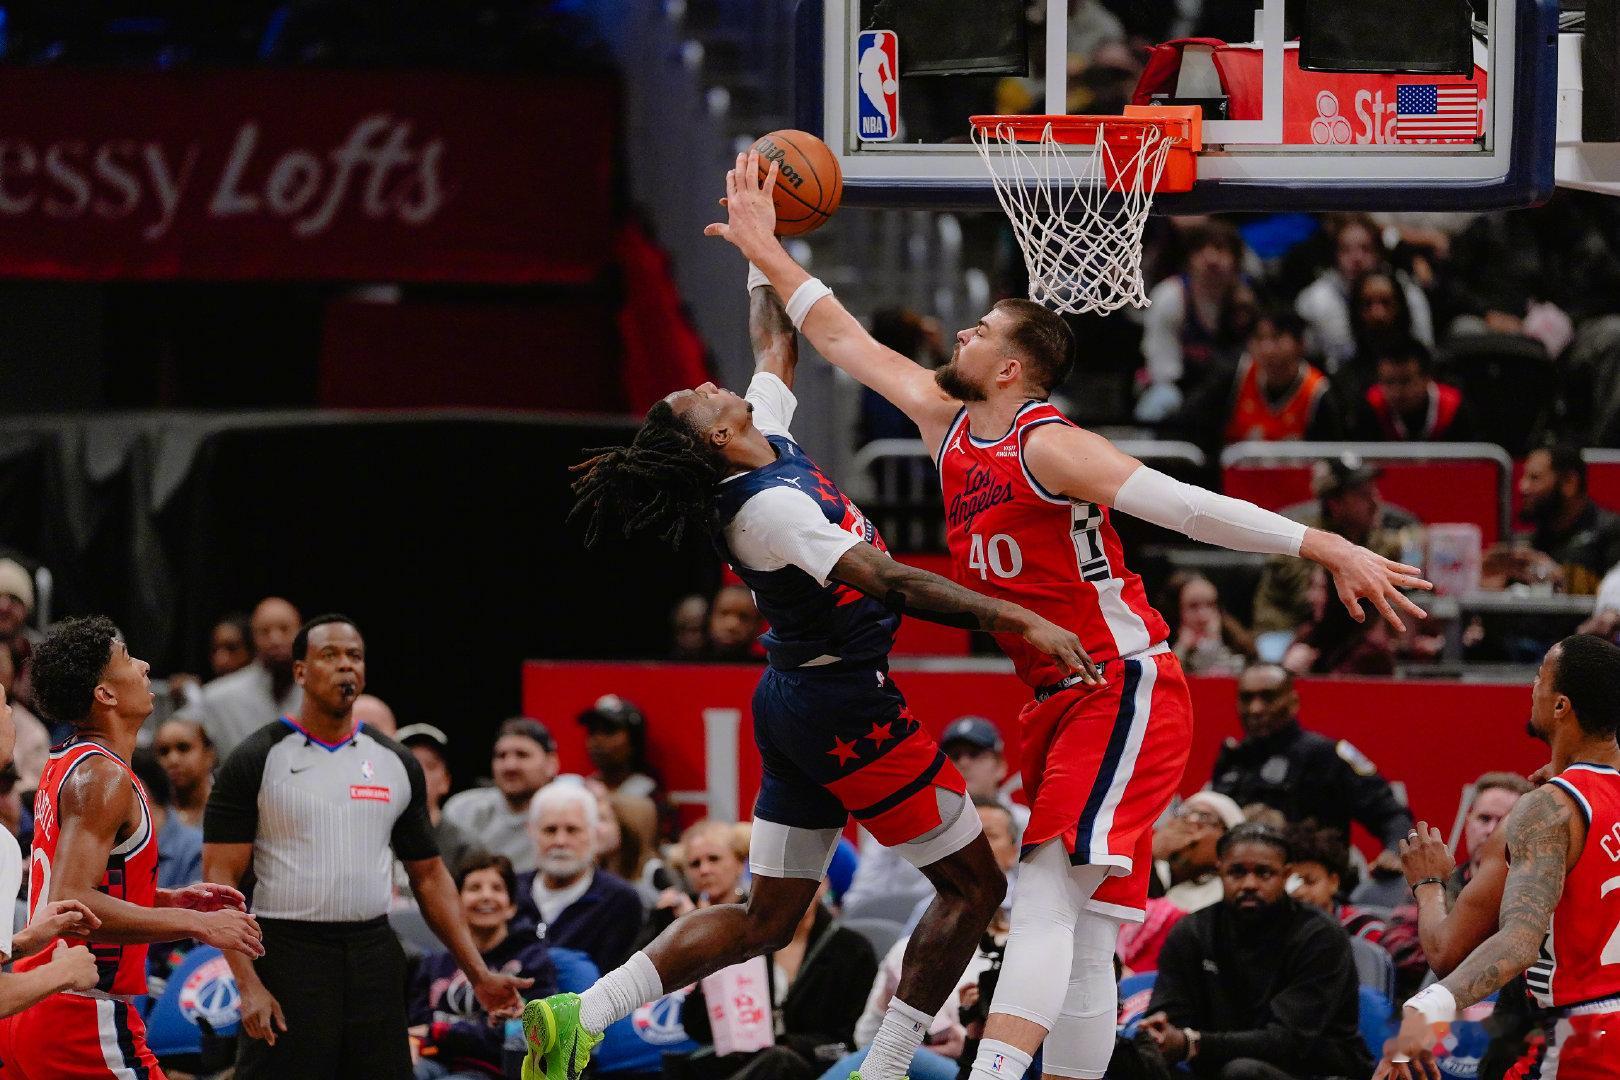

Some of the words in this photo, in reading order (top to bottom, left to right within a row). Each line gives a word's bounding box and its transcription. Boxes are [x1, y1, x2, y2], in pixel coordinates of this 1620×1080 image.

[862, 116, 883, 134] NBA
[207, 113, 447, 238] Lofts
[963, 461, 990, 496] Los
[948, 476, 1014, 533] Angeles
[969, 533, 1023, 580] 40
